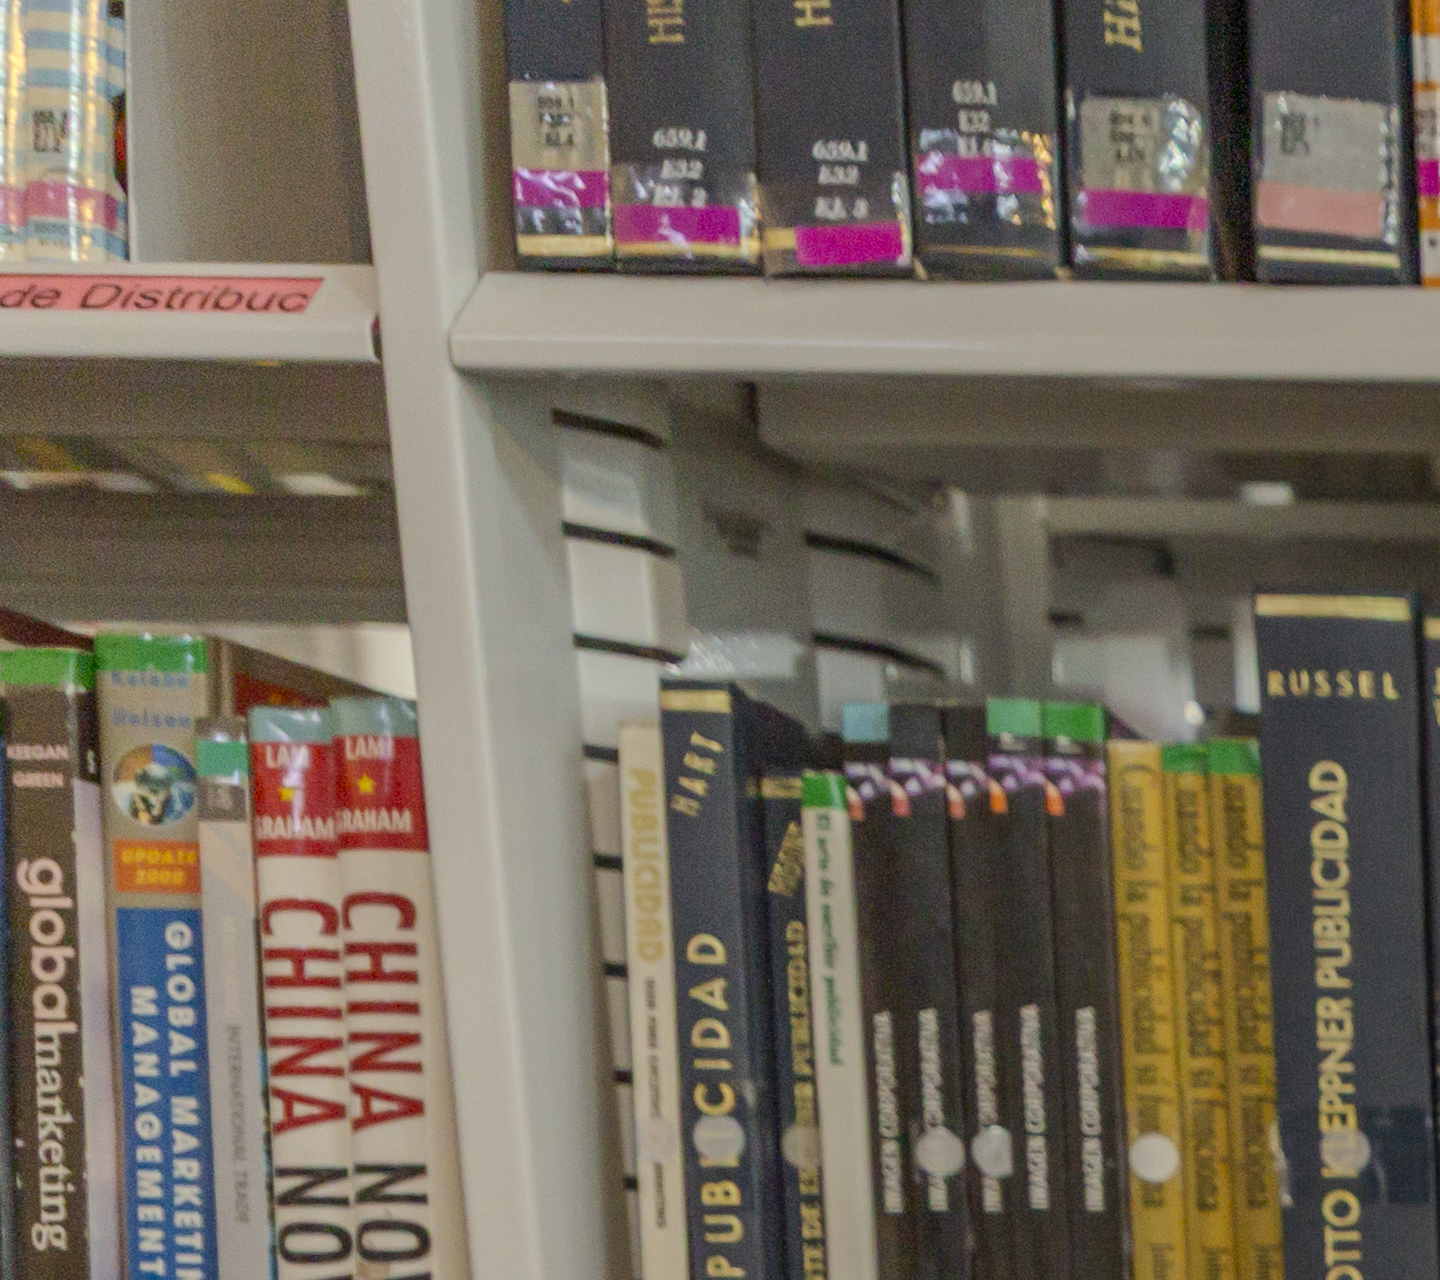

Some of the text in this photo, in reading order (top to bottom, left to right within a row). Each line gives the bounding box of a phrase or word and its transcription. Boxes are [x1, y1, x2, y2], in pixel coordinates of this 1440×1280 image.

[1308, 760, 1353, 989] PUBLICIDAD
[163, 922, 197, 1079] GLOBAL
[262, 898, 348, 1135] CHINA
[340, 891, 426, 1133] CHINA
[686, 931, 747, 1279] PUBLCIDAD
